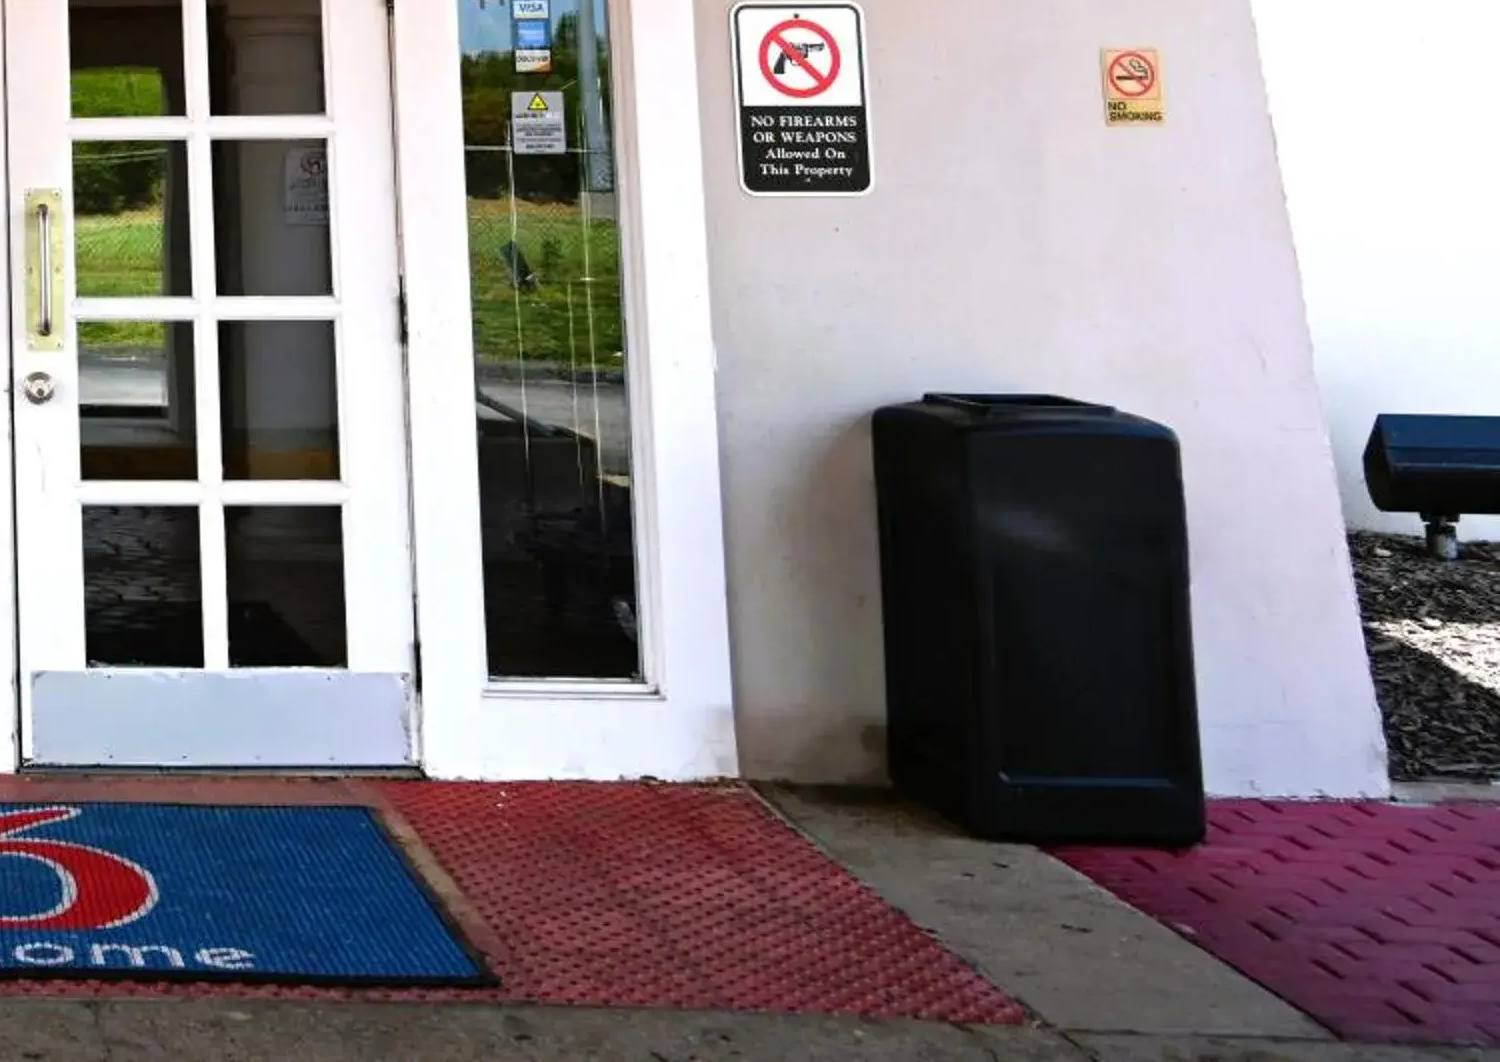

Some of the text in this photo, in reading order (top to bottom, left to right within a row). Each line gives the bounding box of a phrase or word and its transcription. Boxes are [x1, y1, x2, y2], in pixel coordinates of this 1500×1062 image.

[519, 3, 544, 13] VISA
[1106, 101, 1127, 111] NO
[751, 115, 857, 127] NO FIREARMS
[1108, 111, 1164, 122] SMOKING
[753, 131, 858, 143] OR WEAPONS
[765, 147, 846, 159] Allowed On
[760, 163, 853, 178] This Property
